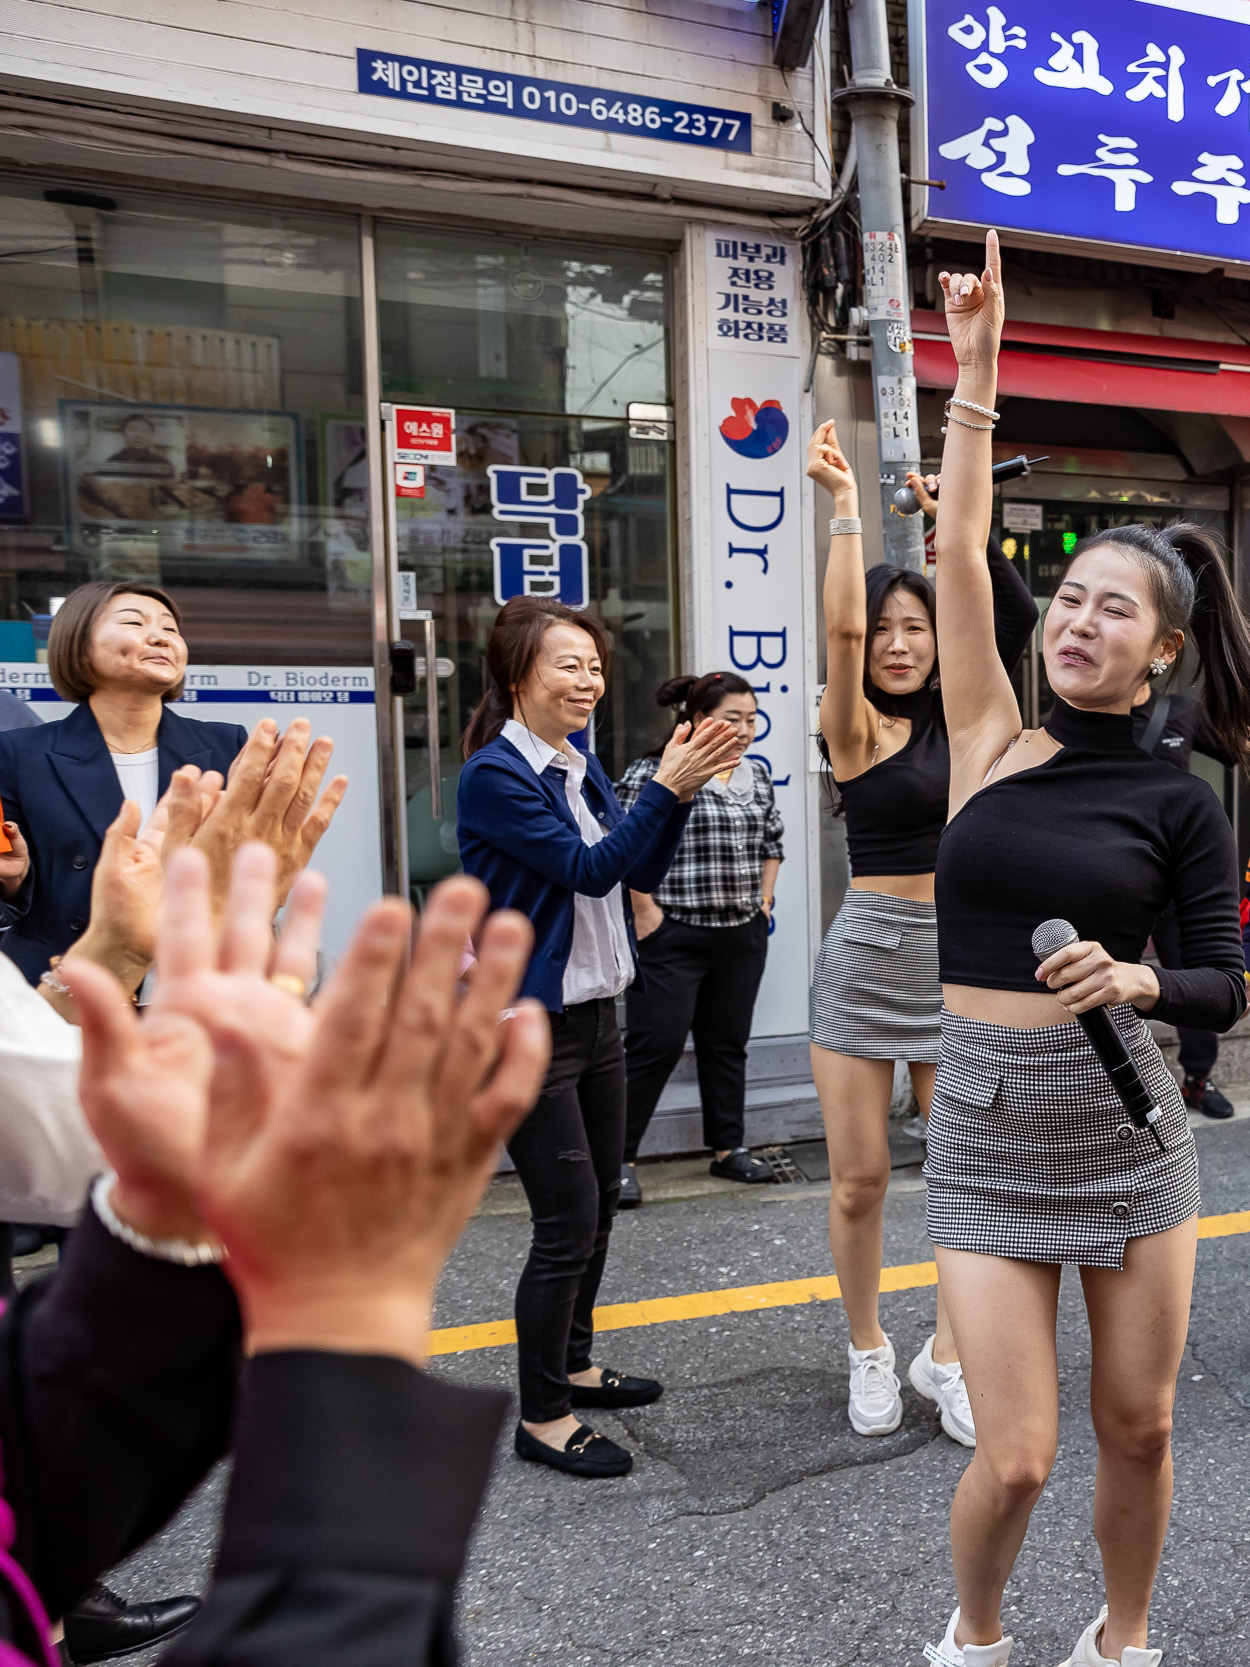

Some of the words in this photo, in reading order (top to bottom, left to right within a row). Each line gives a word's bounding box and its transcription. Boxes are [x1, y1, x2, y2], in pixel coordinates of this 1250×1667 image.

[371, 58, 514, 110] 체인점문의
[522, 86, 742, 142] 010-6486-2377
[715, 238, 787, 265] 피부과
[728, 266, 775, 291] 전용
[717, 292, 788, 318] 기능성
[717, 318, 788, 344] 화장품
[403, 420, 444, 438] 에스원
[487, 464, 593, 611] 닥터
[725, 482, 784, 590] Dr.
[247, 671, 277, 687] Dr.
[285, 671, 368, 687] Bioderm
